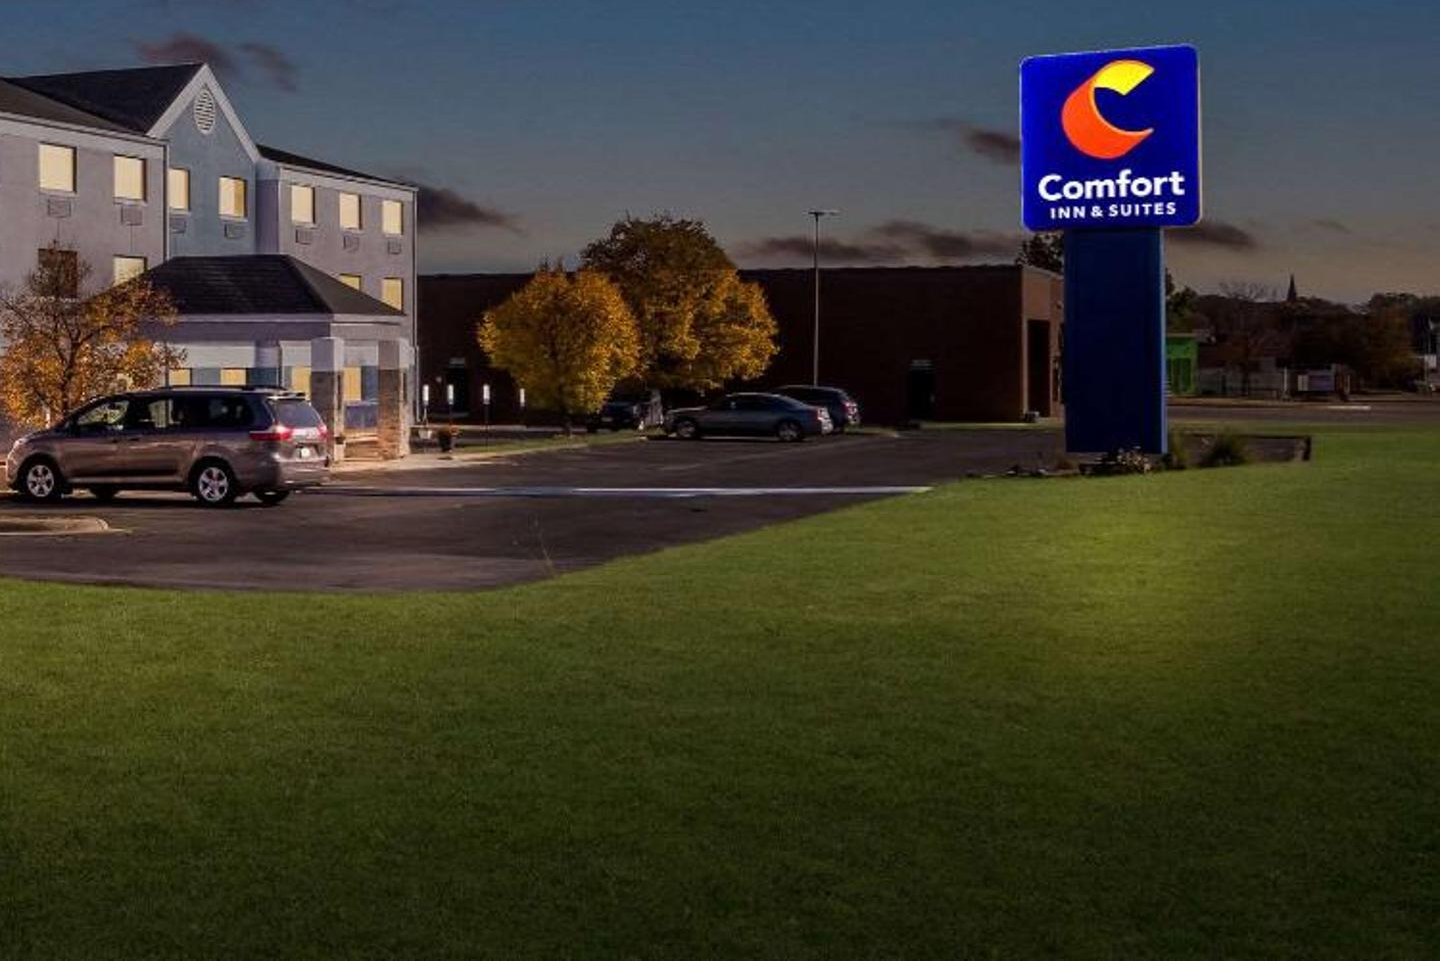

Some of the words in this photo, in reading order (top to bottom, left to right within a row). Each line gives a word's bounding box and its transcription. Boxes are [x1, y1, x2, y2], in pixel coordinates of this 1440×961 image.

[1038, 169, 1185, 201] Comfort
[1050, 205, 1086, 219] INN
[1091, 205, 1104, 218] &
[1109, 202, 1177, 217] SUITES
